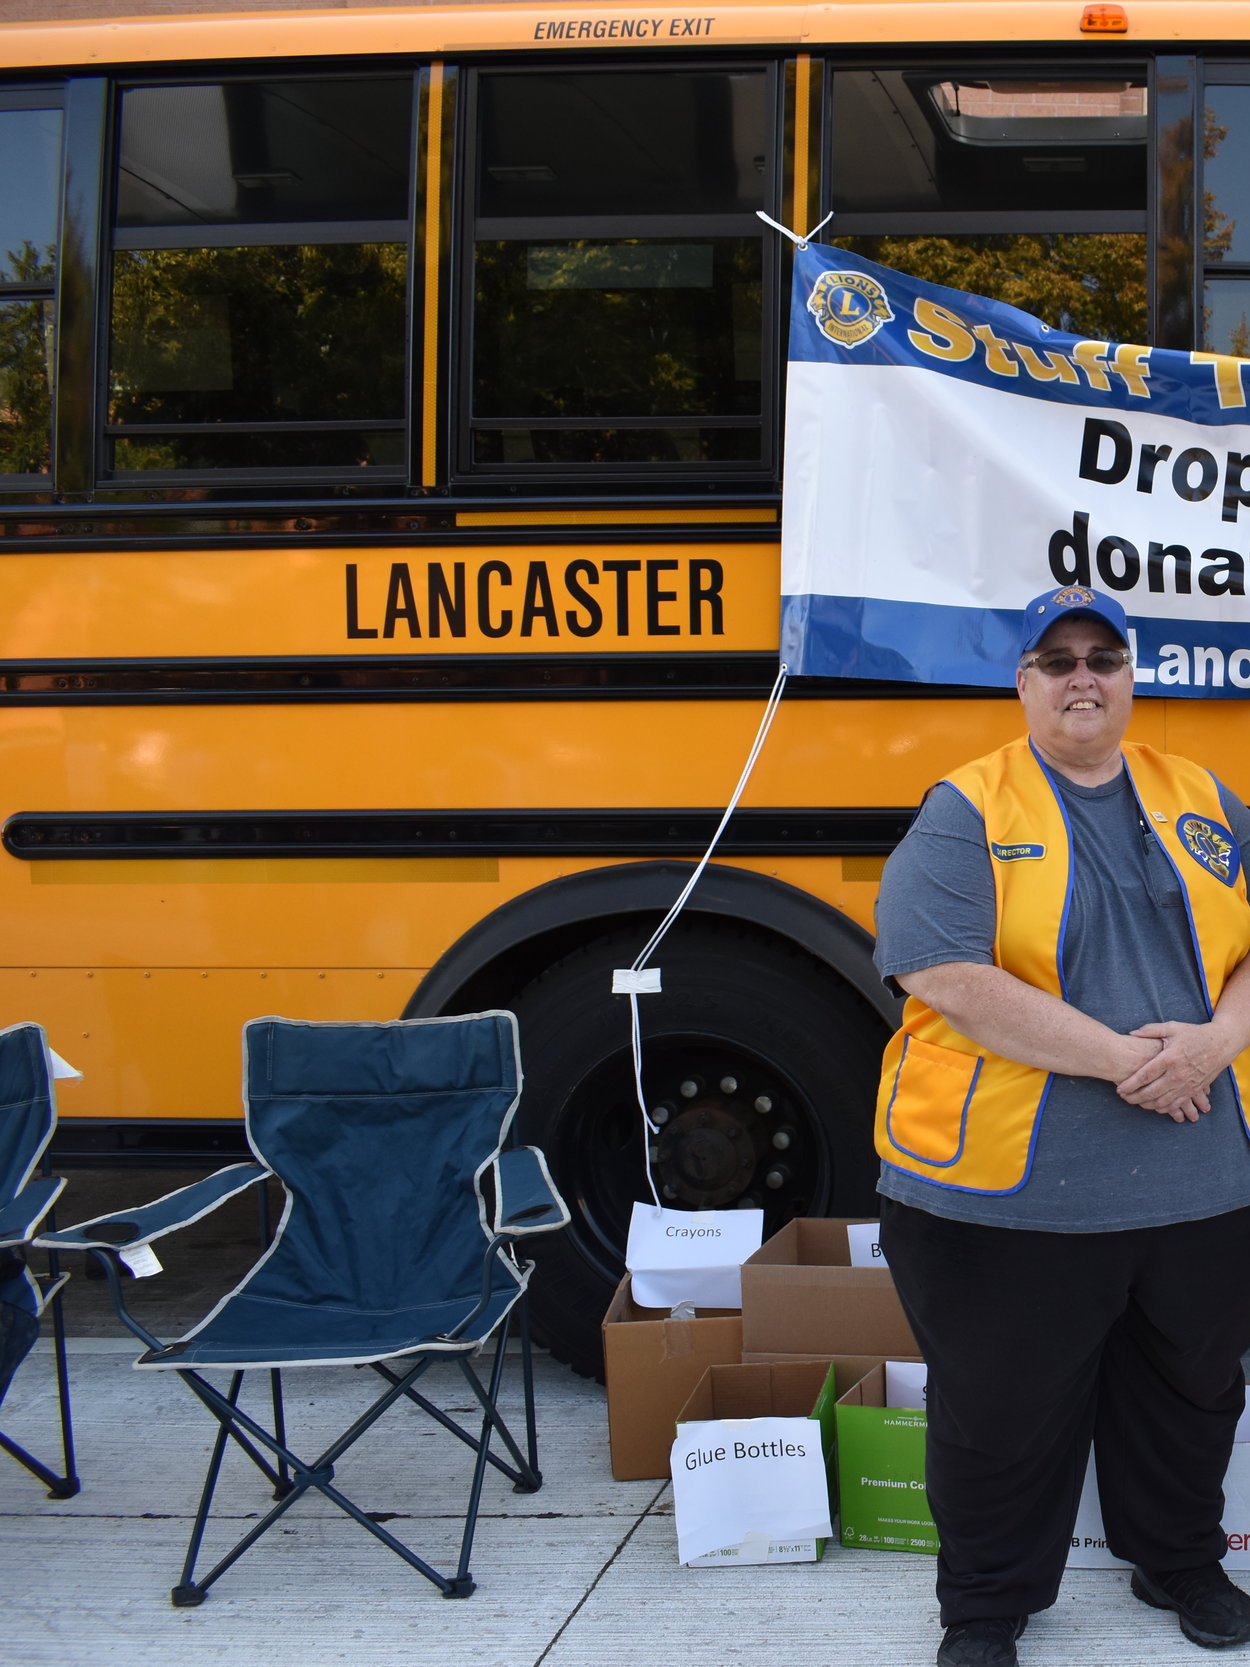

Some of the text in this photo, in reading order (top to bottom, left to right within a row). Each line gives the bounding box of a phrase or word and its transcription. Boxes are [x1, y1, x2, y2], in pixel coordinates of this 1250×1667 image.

[534, 18, 715, 40] EMERGENCY EXIT
[829, 275, 877, 296] LIONS
[907, 297, 1153, 399] Stuff
[346, 559, 726, 639] LANCASTER
[665, 1226, 722, 1239] Crayons
[884, 1419, 928, 1428] HAMMERMI
[685, 1439, 806, 1471] Glue Bottles
[861, 1476, 907, 1489] Premium
